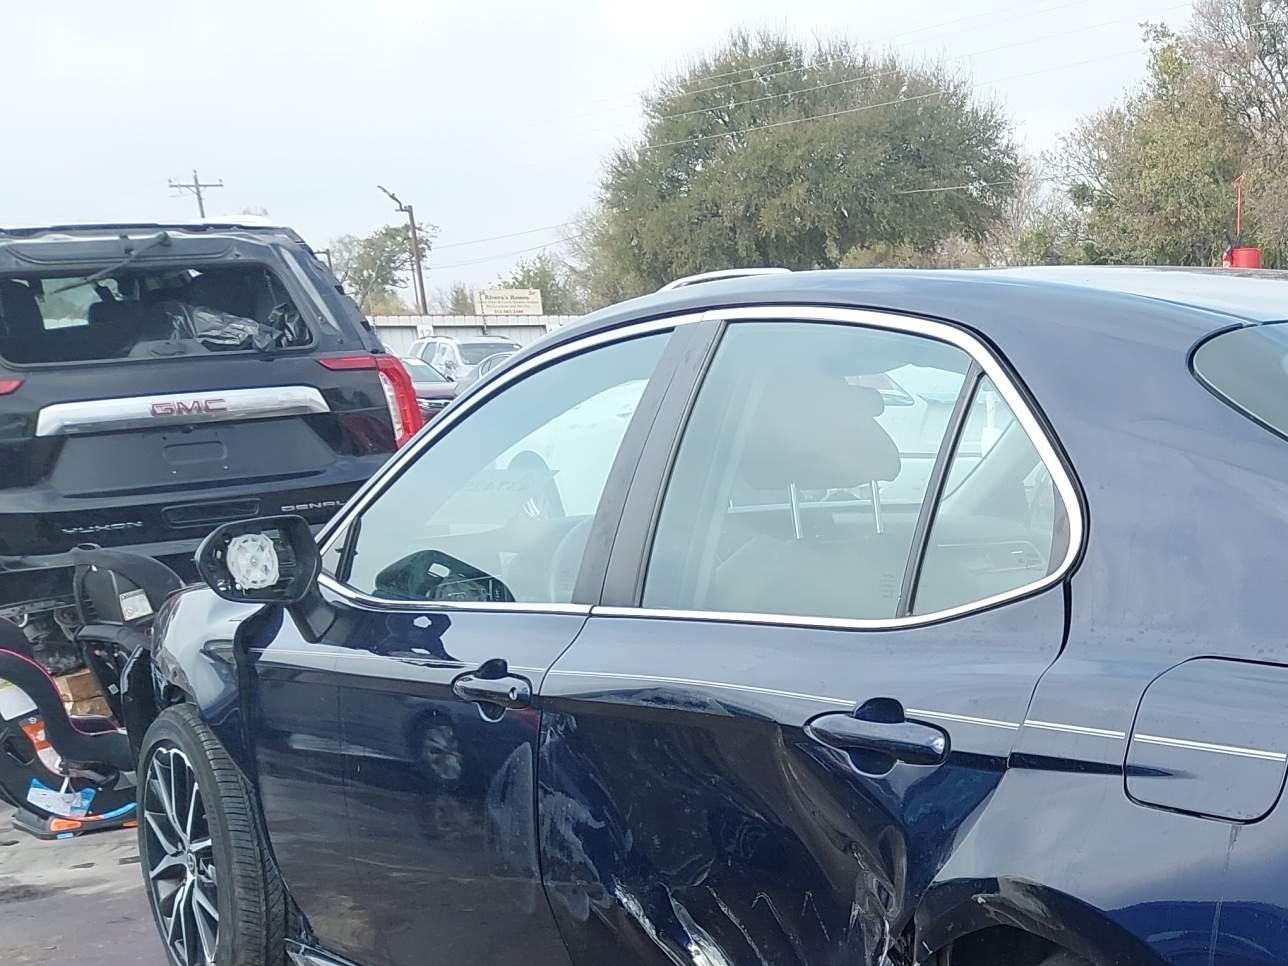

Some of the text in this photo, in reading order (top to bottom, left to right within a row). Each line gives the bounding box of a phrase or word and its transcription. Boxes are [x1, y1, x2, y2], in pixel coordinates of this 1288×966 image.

[151, 399, 228, 416] GMC
[280, 500, 346, 512] DENAL
[61, 520, 144, 534] YUKON
